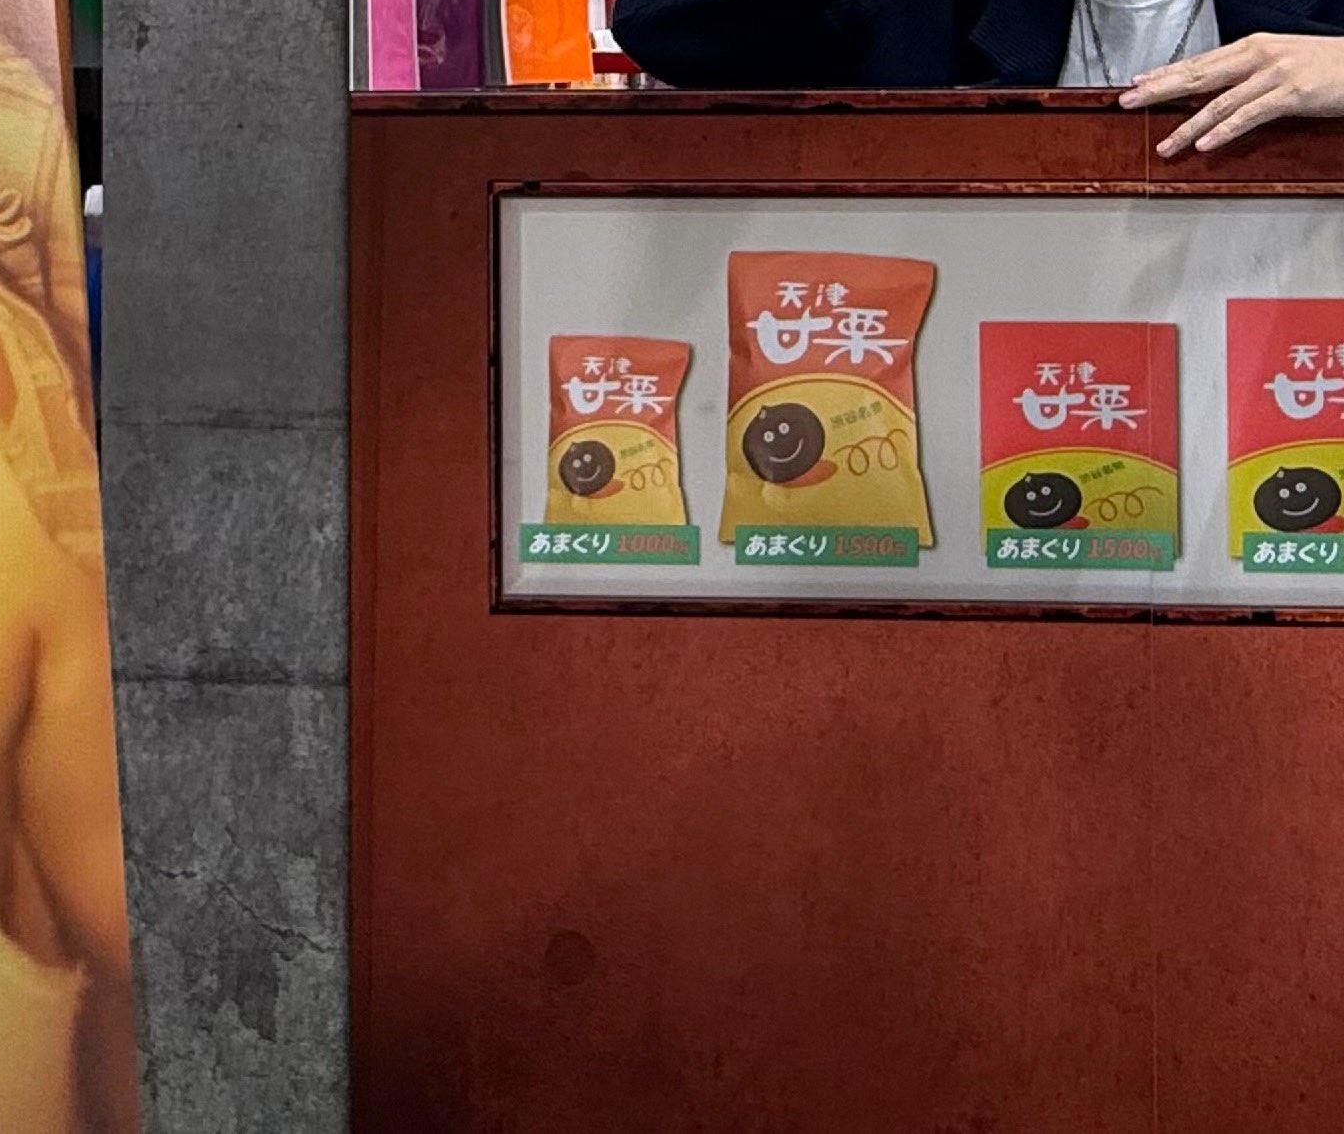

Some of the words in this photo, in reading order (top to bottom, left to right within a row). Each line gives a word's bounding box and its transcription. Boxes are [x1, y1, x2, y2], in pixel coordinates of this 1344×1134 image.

[777, 281, 850, 309] 天津
[745, 307, 910, 365] 甘栗
[581, 356, 632, 374] 天津
[1034, 361, 1097, 386] 天津
[561, 374, 673, 415] 甘栗
[1012, 383, 1148, 431] 甘栗
[528, 531, 610, 555] あまぐり
[744, 534, 828, 557] あまぐり
[996, 536, 1082, 560] あまぐり
[1252, 540, 1339, 564] あまぐり
